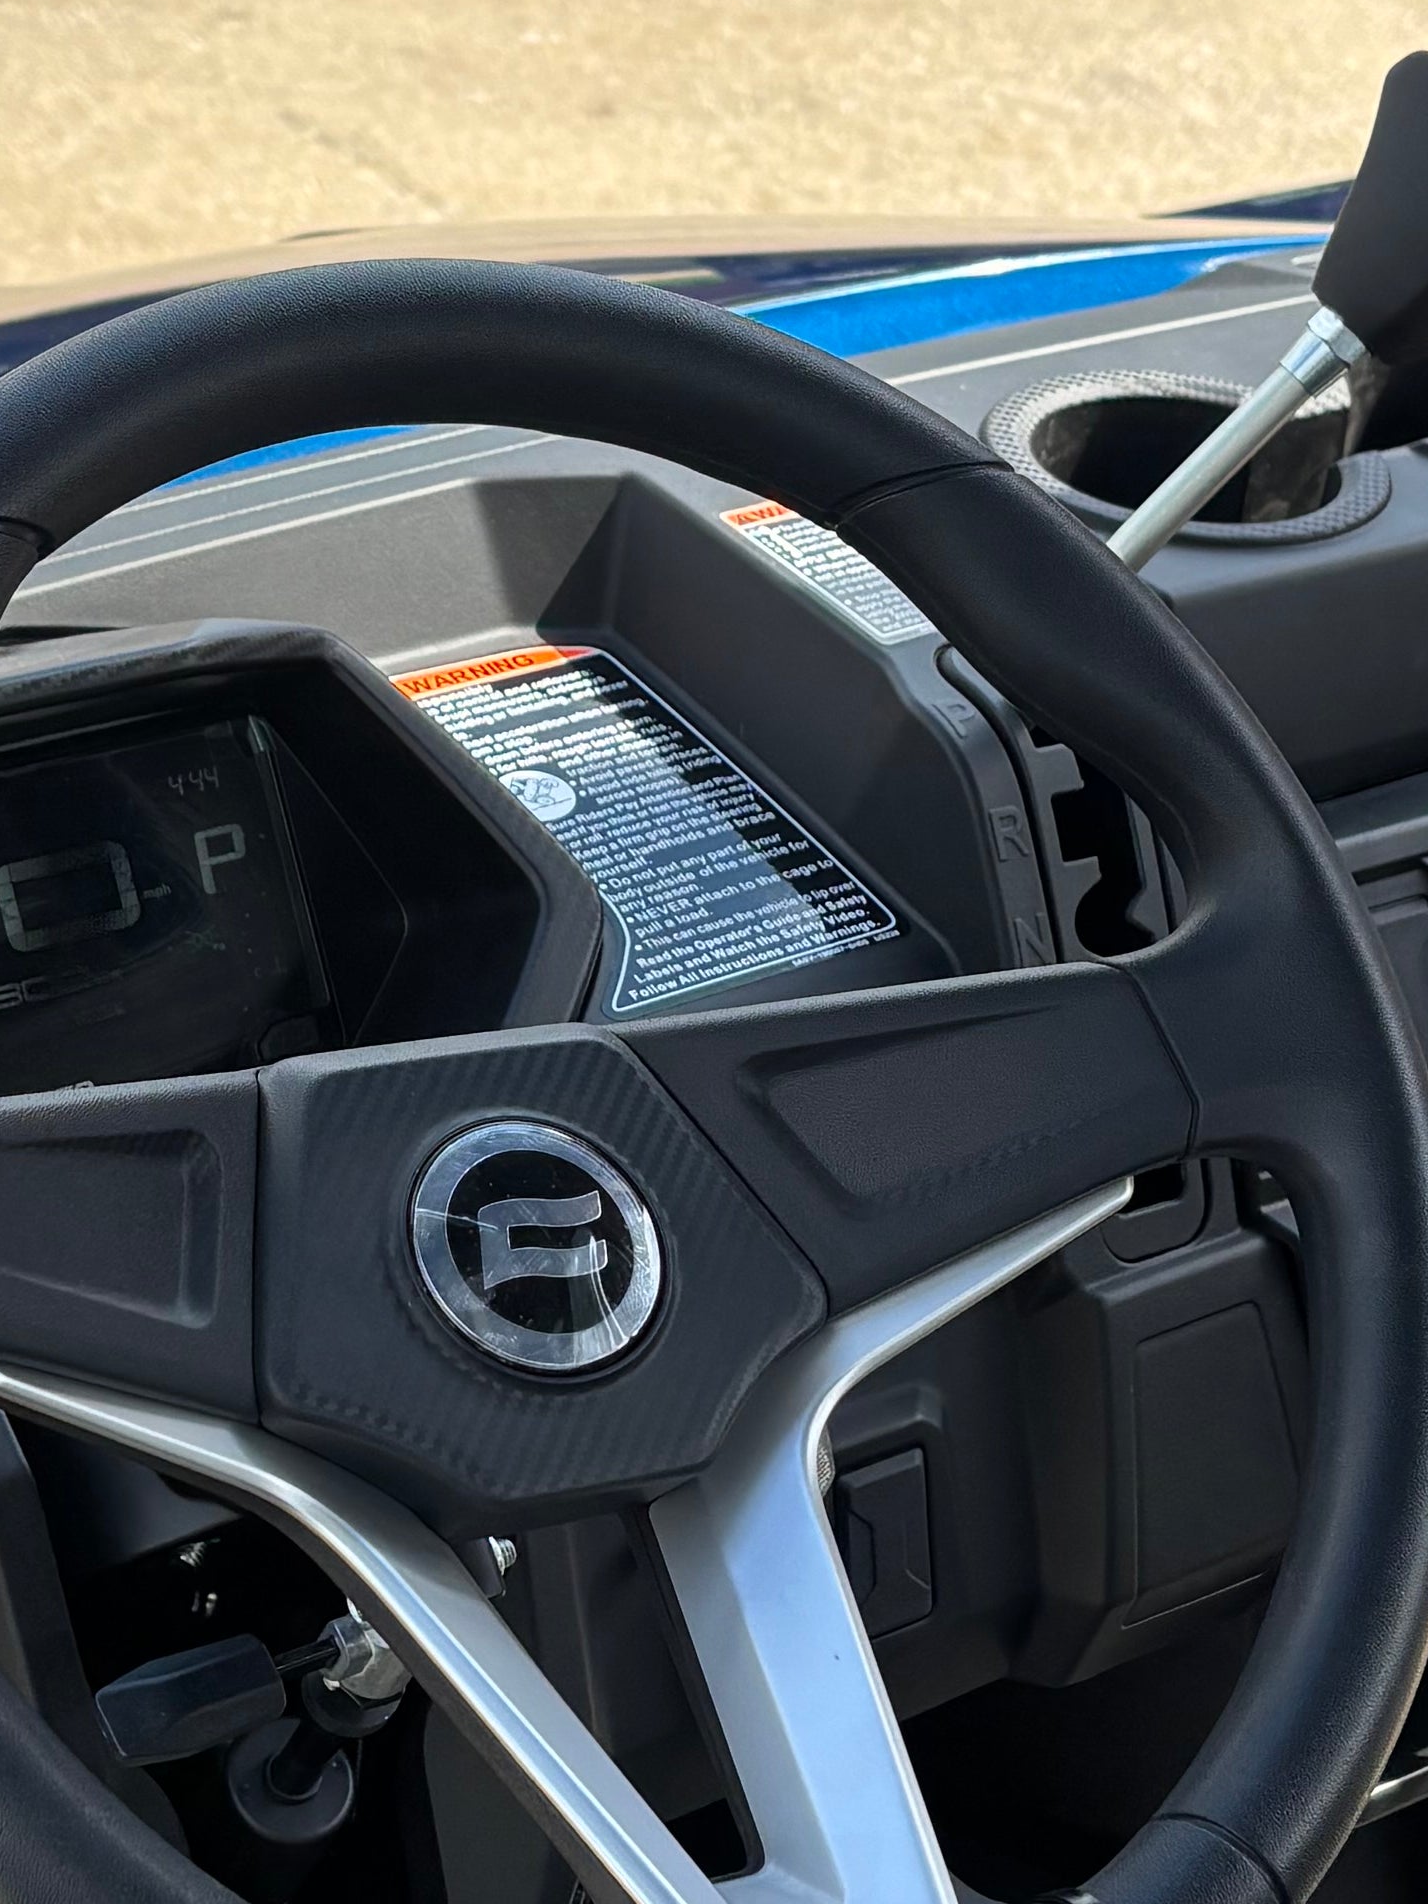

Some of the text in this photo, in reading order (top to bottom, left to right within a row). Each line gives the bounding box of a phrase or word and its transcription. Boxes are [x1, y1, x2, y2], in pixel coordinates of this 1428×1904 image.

[404, 653, 534, 695] WARNING
[193, 823, 247, 895] P
[988, 805, 1029, 862] R
[628, 980, 678, 1001] Follow
[678, 971, 700, 986] All
[698, 947, 784, 978] Instructions
[784, 937, 813, 953] and
[809, 920, 881, 944] Warnings.
